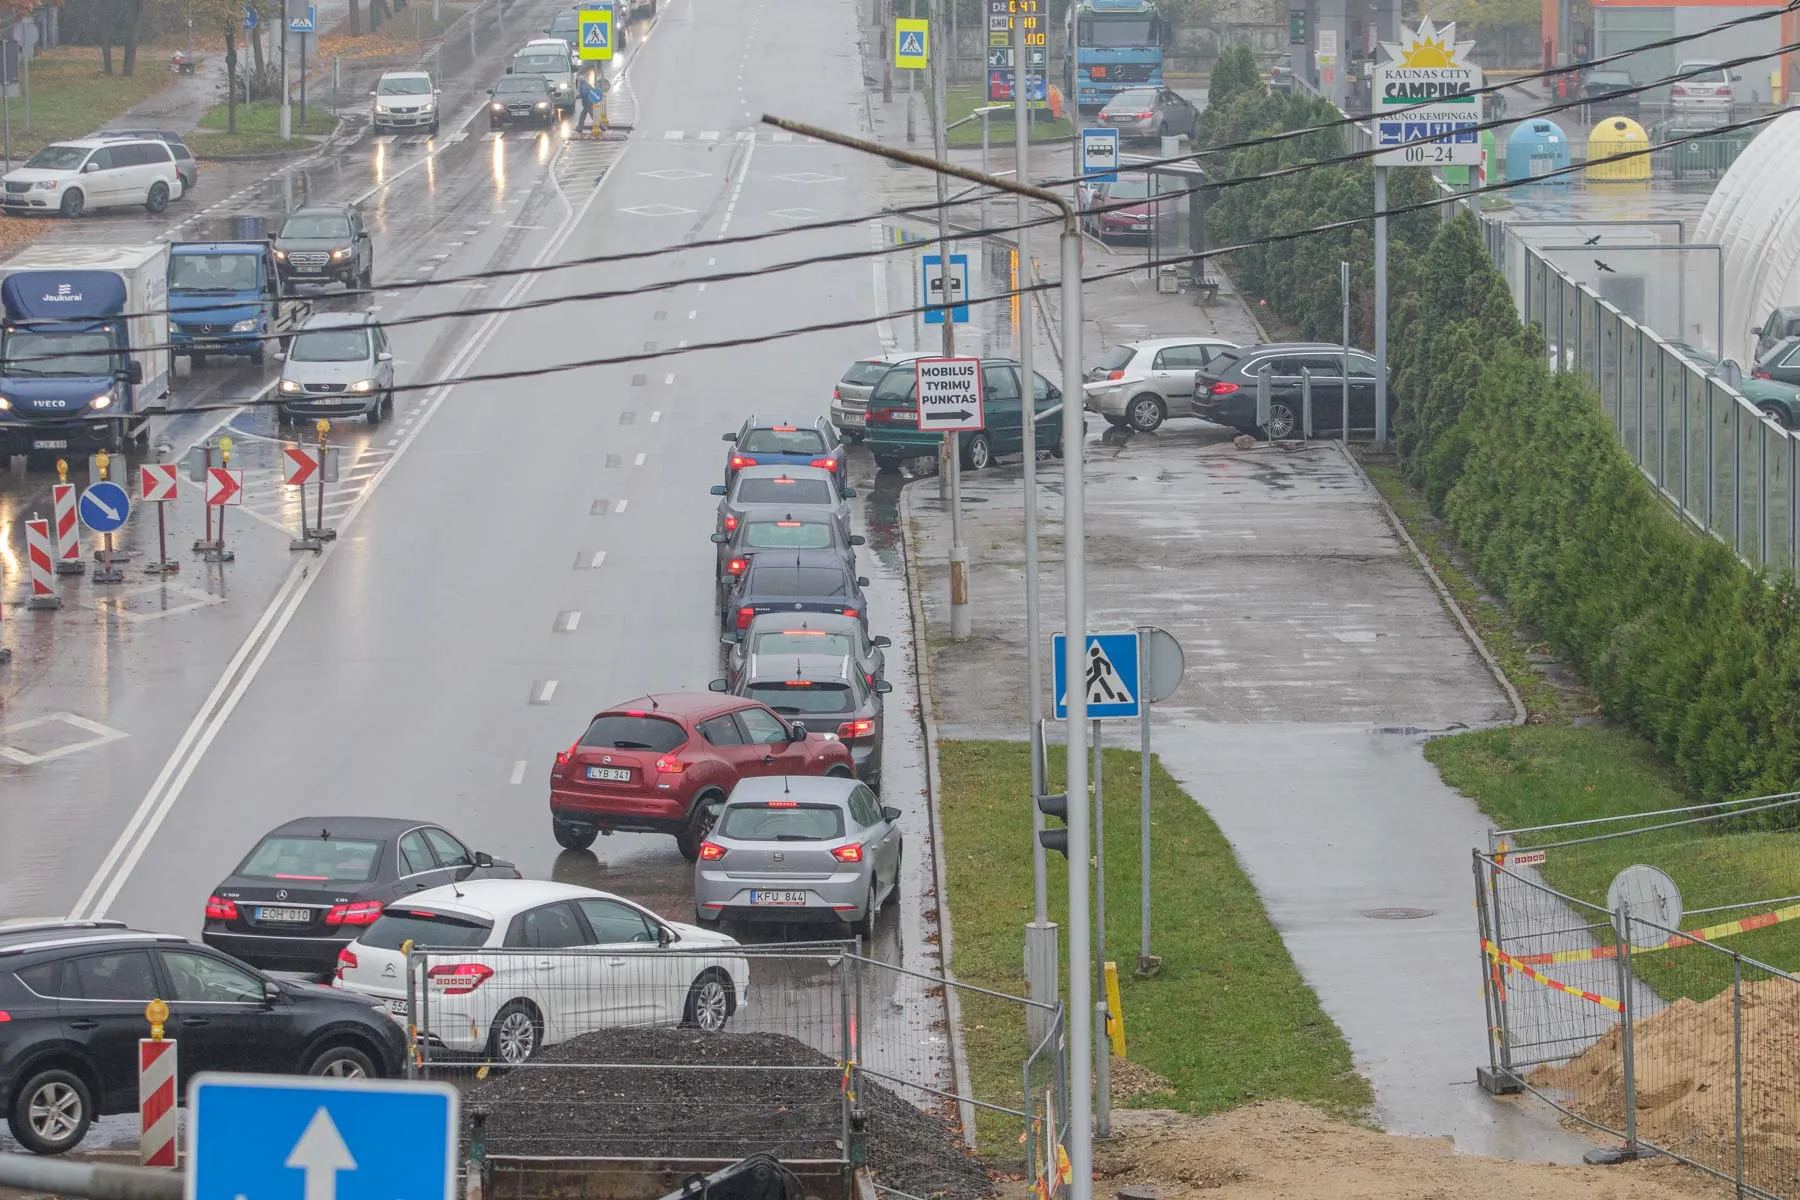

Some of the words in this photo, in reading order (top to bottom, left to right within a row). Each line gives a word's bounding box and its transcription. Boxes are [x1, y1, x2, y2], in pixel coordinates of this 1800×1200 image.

[1385, 69, 1437, 79] KAUNAS
[1440, 69, 1471, 79] CITY
[1385, 82, 1471, 98] CAMPING
[1419, 112, 1478, 120] KEMPINGAS
[1405, 147, 1453, 162] 00-24
[42, 293, 82, 302] Jaukurai
[921, 366, 975, 377] MOBILUS
[926, 380, 970, 392] TYRIMŲ
[33, 400, 66, 408] IVECO
[922, 394, 977, 405] PUNKTAS
[592, 767, 609, 778] LYB
[614, 770, 629, 780] 341
[757, 892, 779, 902] KFU
[785, 892, 803, 902] 844
[262, 908, 284, 919] EOH
[290, 910, 308, 920] 010
